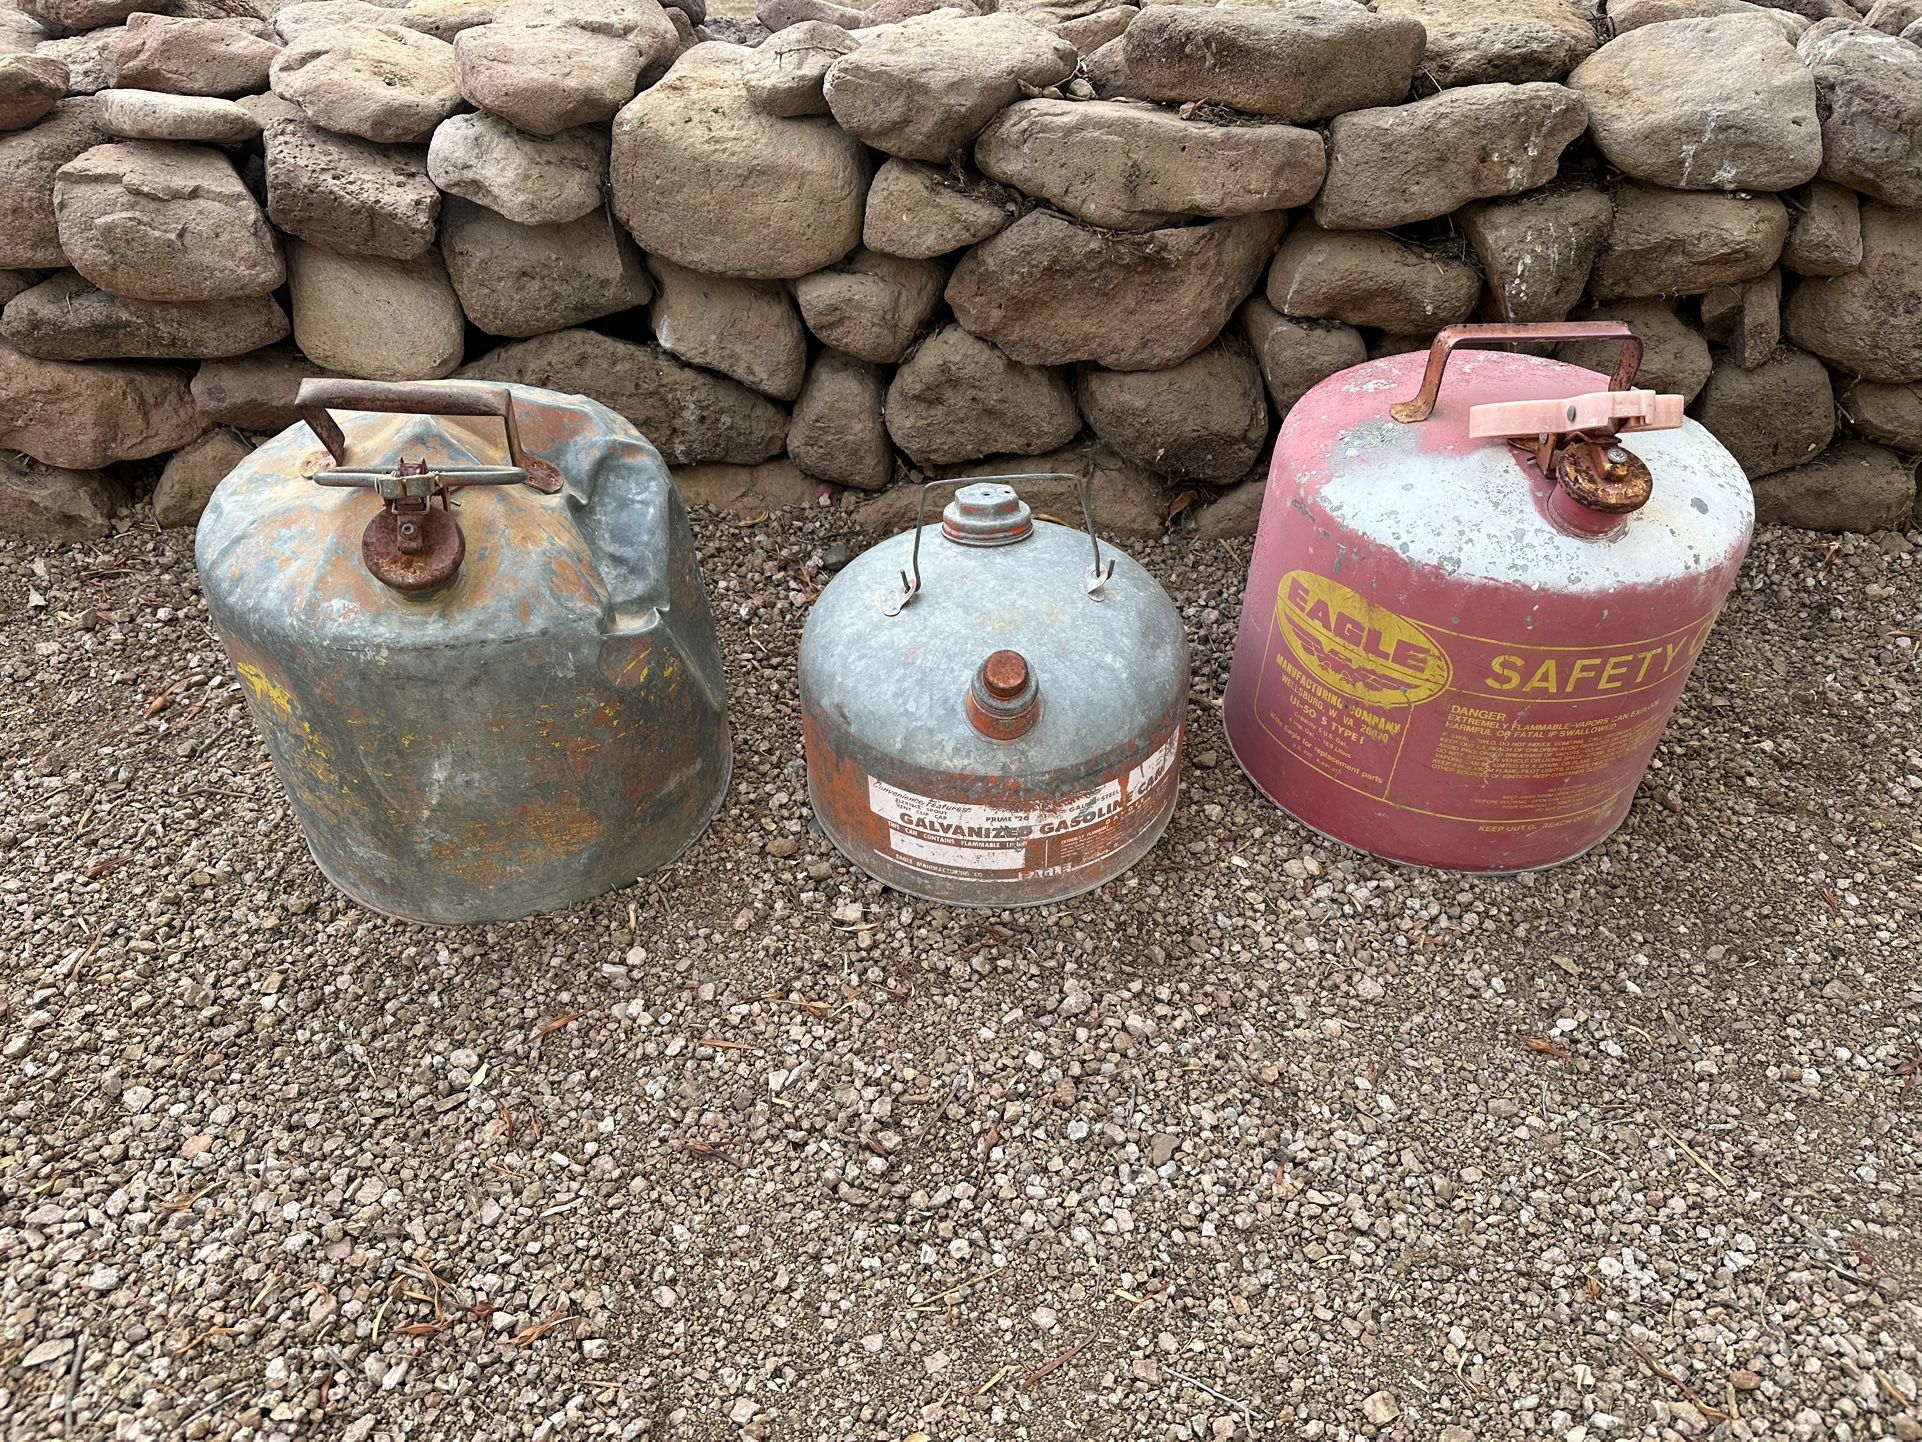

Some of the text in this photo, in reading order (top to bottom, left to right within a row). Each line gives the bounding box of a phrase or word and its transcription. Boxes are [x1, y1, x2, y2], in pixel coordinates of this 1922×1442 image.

[1287, 575, 1431, 674] EAGLE
[1485, 635, 1688, 693] SAFETY
[1276, 653, 1342, 709] MANUFACTURING
[1282, 673, 1325, 713] WELLSBURG,
[1343, 715, 1356, 728] VA.
[1451, 705, 1507, 721] DANGER
[1320, 716, 1328, 726] S
[1331, 721, 1358, 741] TYPE
[1445, 721, 1493, 736] HARMFUL
[1547, 730, 1557, 738] IF
[1447, 713, 1510, 730] EXTREMELY
[1511, 716, 1610, 731] FLAMMABLE-VAPORS
[1612, 712, 1630, 722] CAN
[1302, 738, 1312, 748] for
[1314, 746, 1360, 774] replacement
[1361, 771, 1383, 784] parts
[872, 779, 925, 806] Convenience
[900, 812, 1034, 839] GALVANIZED
[1137, 765, 1165, 795] CAN
[985, 815, 1012, 823] PRIME
[1100, 789, 1120, 802] STEEL
[926, 807, 948, 816] SPOUT
[887, 820, 900, 830] THIS
[905, 827, 918, 836] CAN
[923, 833, 955, 845] CONTAINS
[961, 840, 1001, 848] FLAMMABLE
